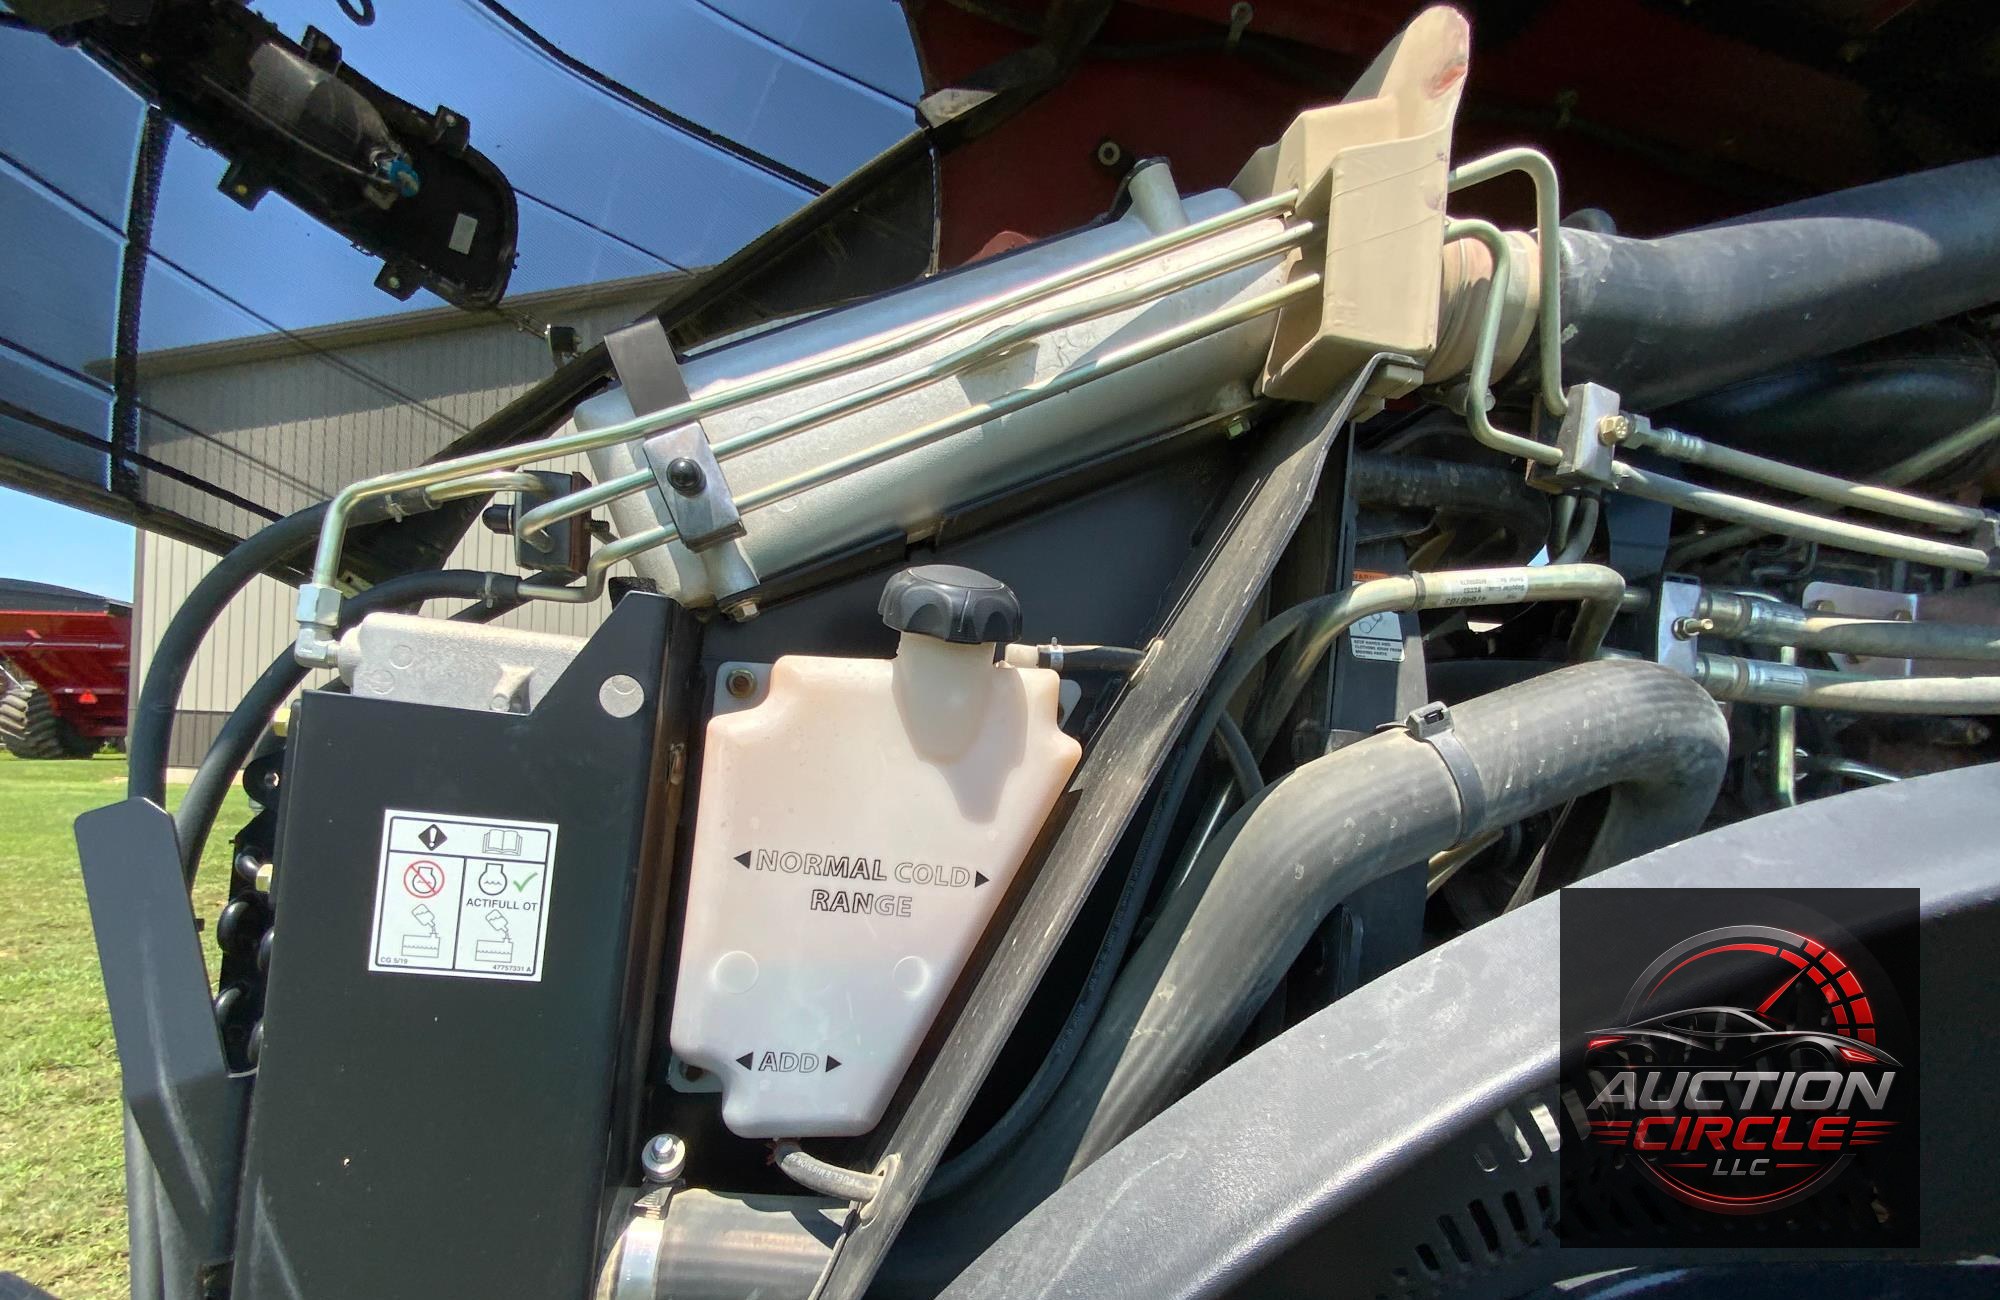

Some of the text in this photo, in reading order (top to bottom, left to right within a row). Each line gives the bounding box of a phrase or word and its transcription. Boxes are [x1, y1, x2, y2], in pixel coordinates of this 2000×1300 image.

[756, 849, 970, 888] NORMAL COLD
[466, 898, 538, 912] ACTIFULL OT
[810, 889, 913, 917] RANGE
[758, 1052, 819, 1073] ADD
